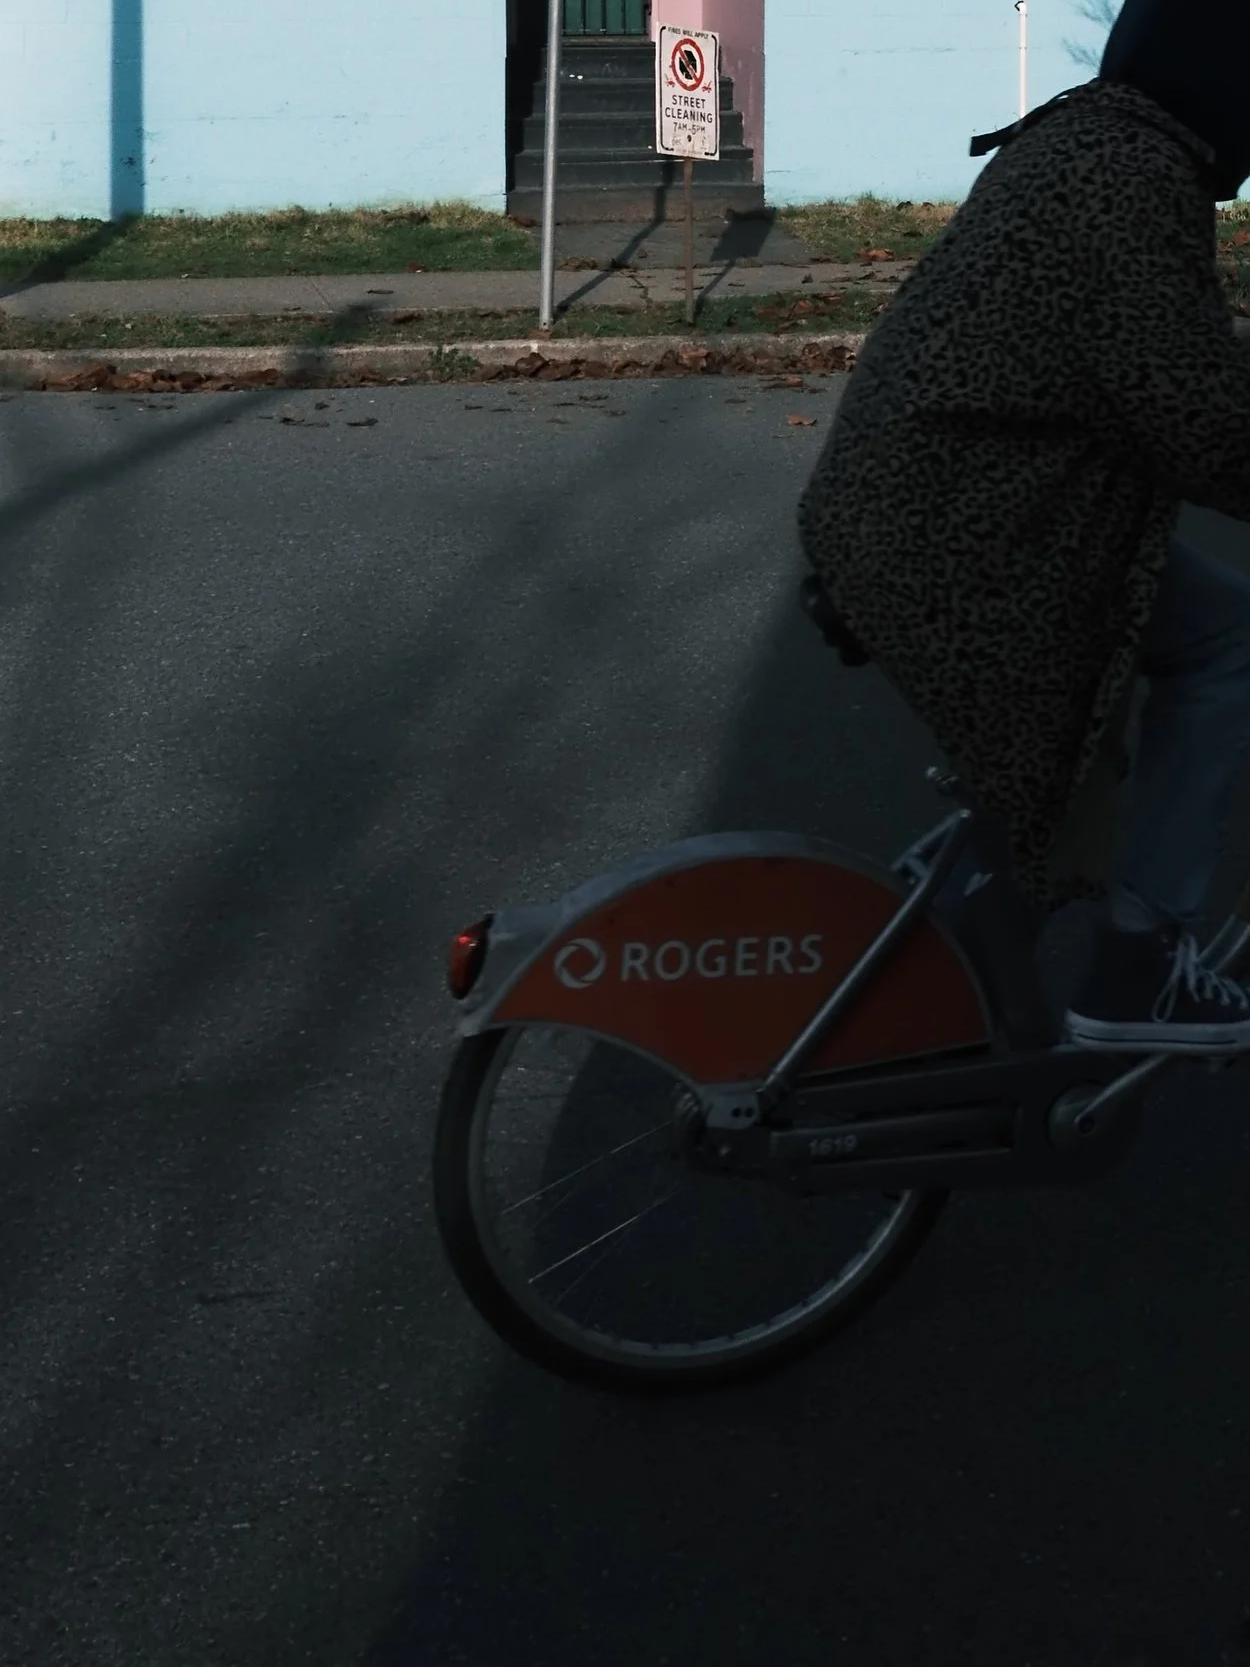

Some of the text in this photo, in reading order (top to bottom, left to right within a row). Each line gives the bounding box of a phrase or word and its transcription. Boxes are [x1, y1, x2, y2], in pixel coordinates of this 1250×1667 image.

[683, 29, 694, 37] WILL
[672, 94, 706, 109] STREET
[665, 107, 713, 123] CLEANING
[620, 934, 823, 982] ROGERS
[808, 1134, 858, 1156] 1619
